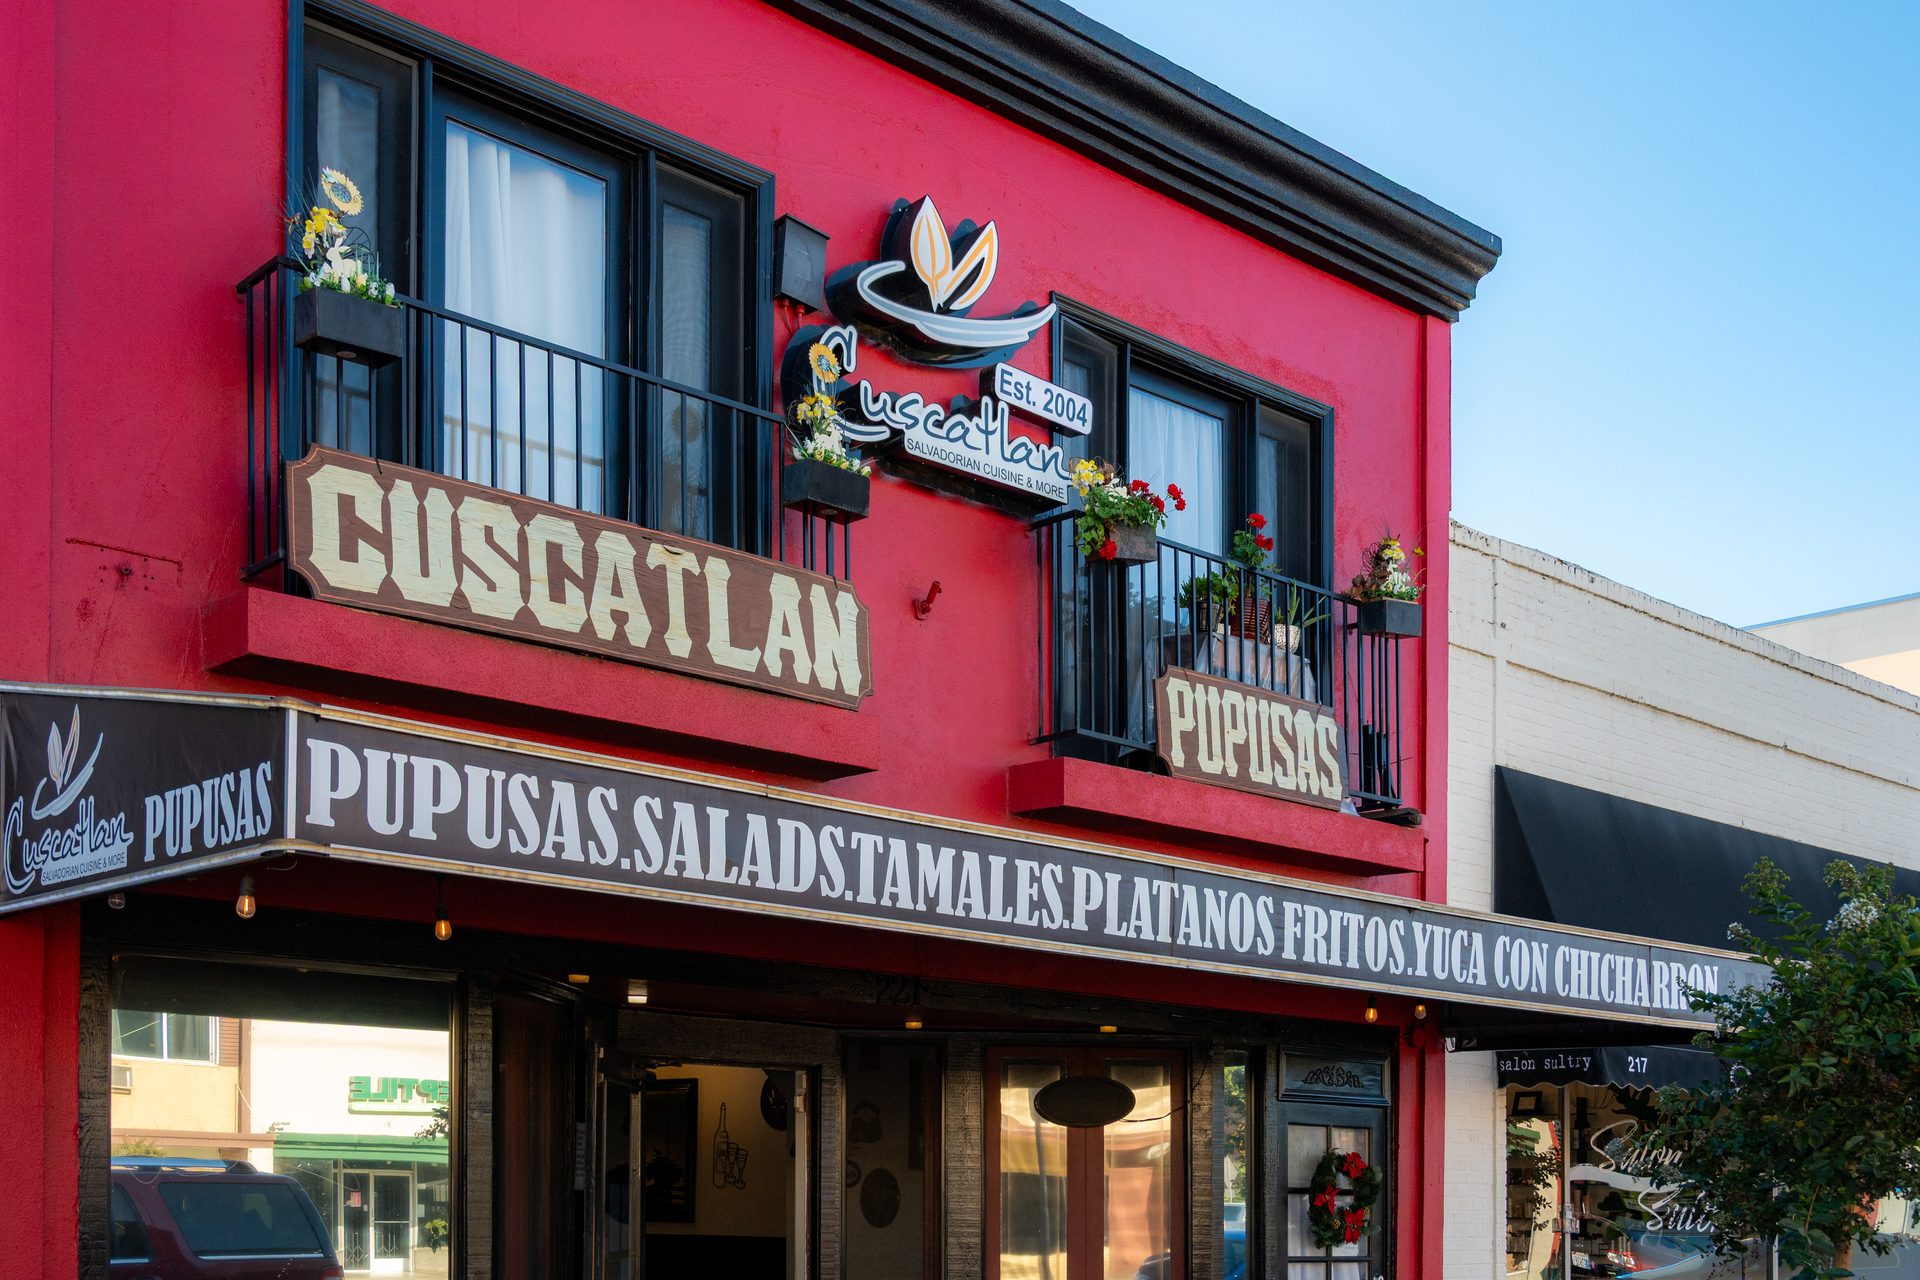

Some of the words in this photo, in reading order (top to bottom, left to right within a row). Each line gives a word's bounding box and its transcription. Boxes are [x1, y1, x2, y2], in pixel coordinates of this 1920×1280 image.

[1000, 368, 1036, 407] Est.
[1043, 387, 1088, 427] 2004
[907, 438, 981, 472] SALVADORIAN
[983, 463, 1024, 486] CUISINE
[1026, 476, 1033, 489] &
[1035, 479, 1065, 500] MORE
[307, 463, 863, 698] CUSCATLAN
[1166, 677, 1343, 801] PUPUSAS
[4, 795, 134, 895] Cuscatlan
[144, 760, 273, 863] PUPUSAS
[42, 866, 80, 883] SALVADORIAN
[80, 857, 102, 875] CUISINE
[103, 856, 108, 869] &
[108, 852, 126, 868] MORE
[1411, 921, 1487, 986] YUCA
[1494, 934, 1551, 994] CON
[1554, 945, 1719, 1011] CHICHARRON
[1500, 1057, 1536, 1072] salon
[1544, 1054, 1592, 1072] sultry
[1628, 1056, 1648, 1074] 217
